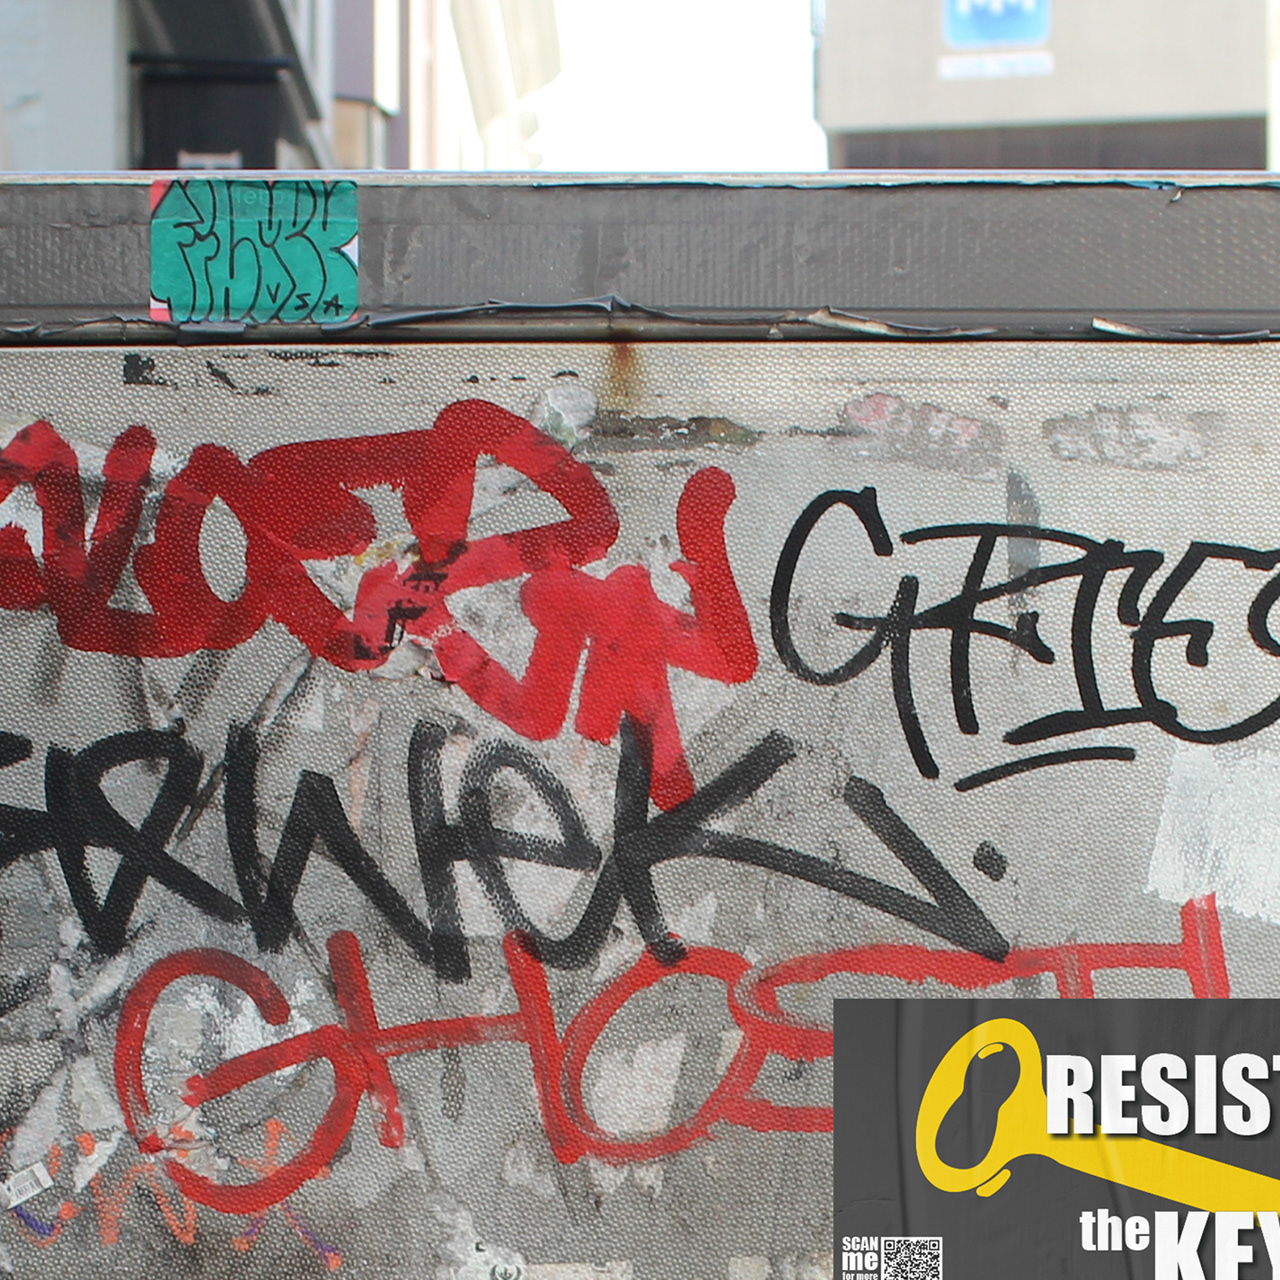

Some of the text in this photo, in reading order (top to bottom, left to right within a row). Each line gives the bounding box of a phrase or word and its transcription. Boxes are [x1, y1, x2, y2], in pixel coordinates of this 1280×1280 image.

[1079, 1208, 1150, 1251] the
[841, 1236, 879, 1251] SCAN
[841, 1251, 879, 1271] me
[841, 1271, 879, 1280] for more
